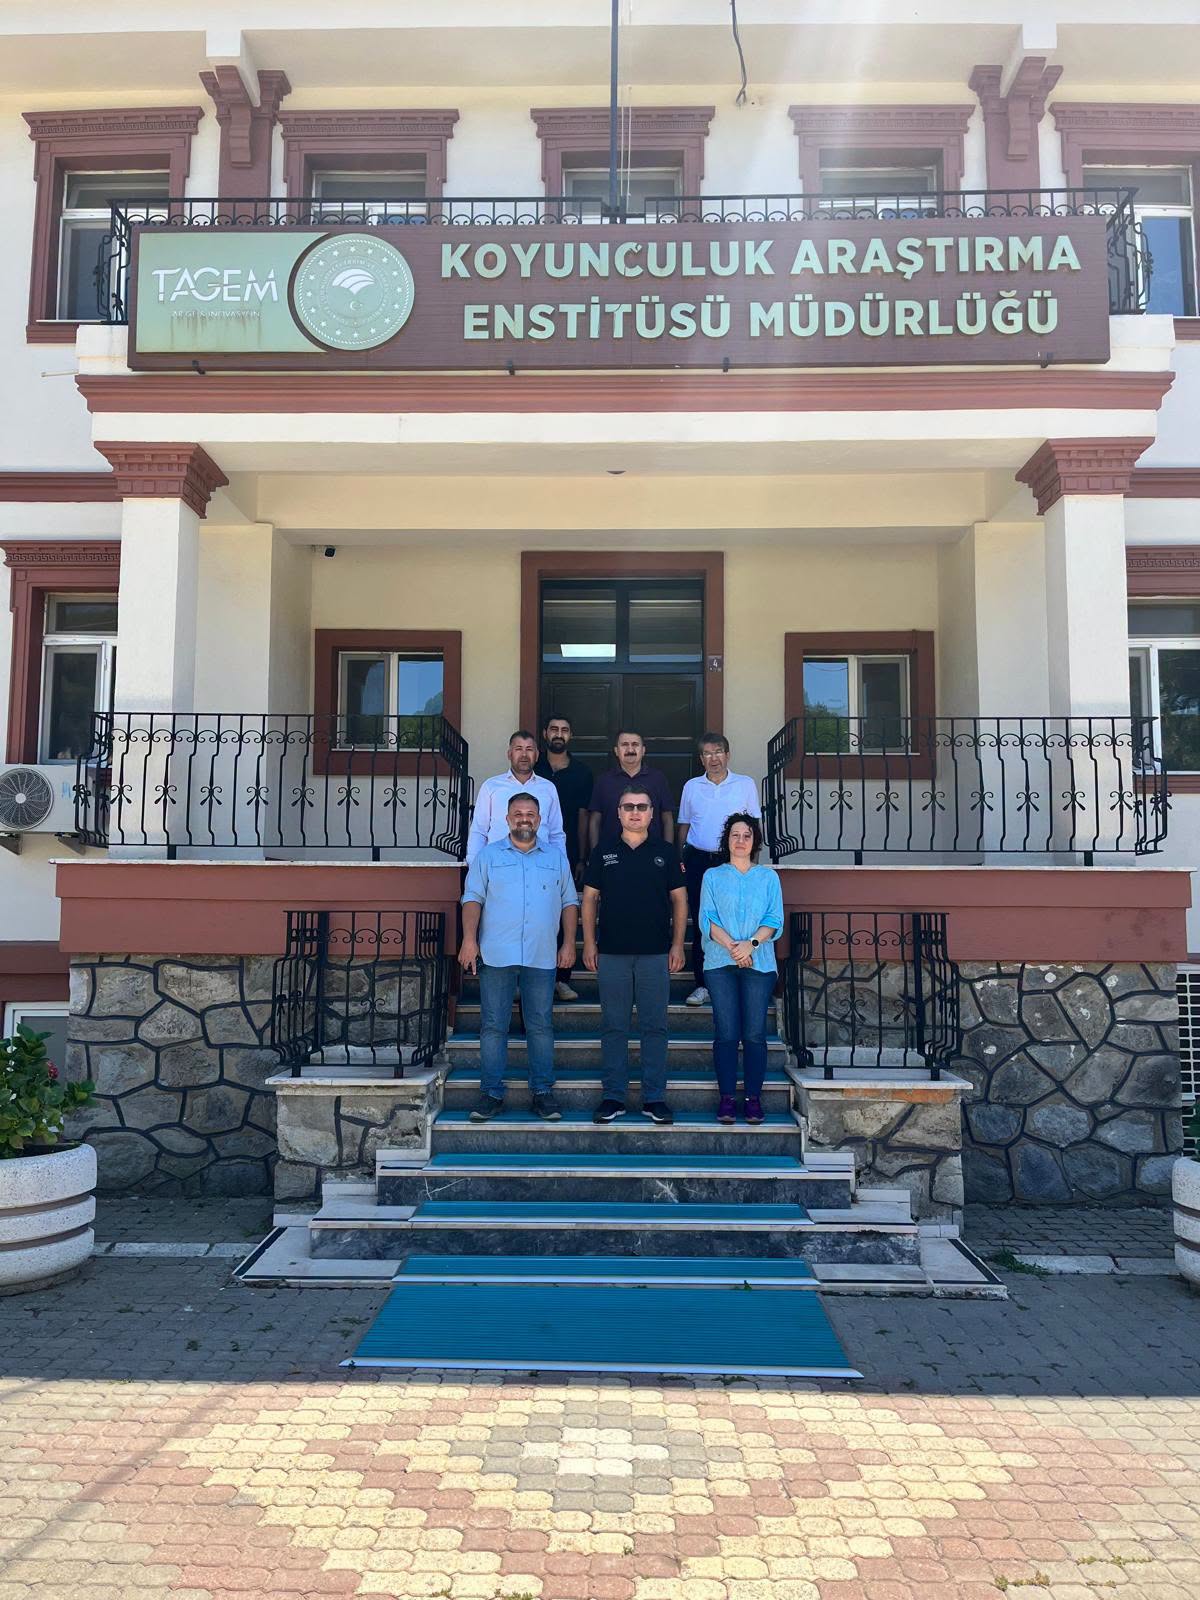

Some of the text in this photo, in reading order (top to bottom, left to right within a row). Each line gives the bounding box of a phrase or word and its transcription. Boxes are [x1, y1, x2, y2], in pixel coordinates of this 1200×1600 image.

[441, 235, 1082, 280] KOYUNCULUK ARAŞTIRMA
[152, 267, 278, 302] TAGEM
[463, 290, 1058, 339] ENSTİTÜSÜ MÜDÜRLÜĞÜ
